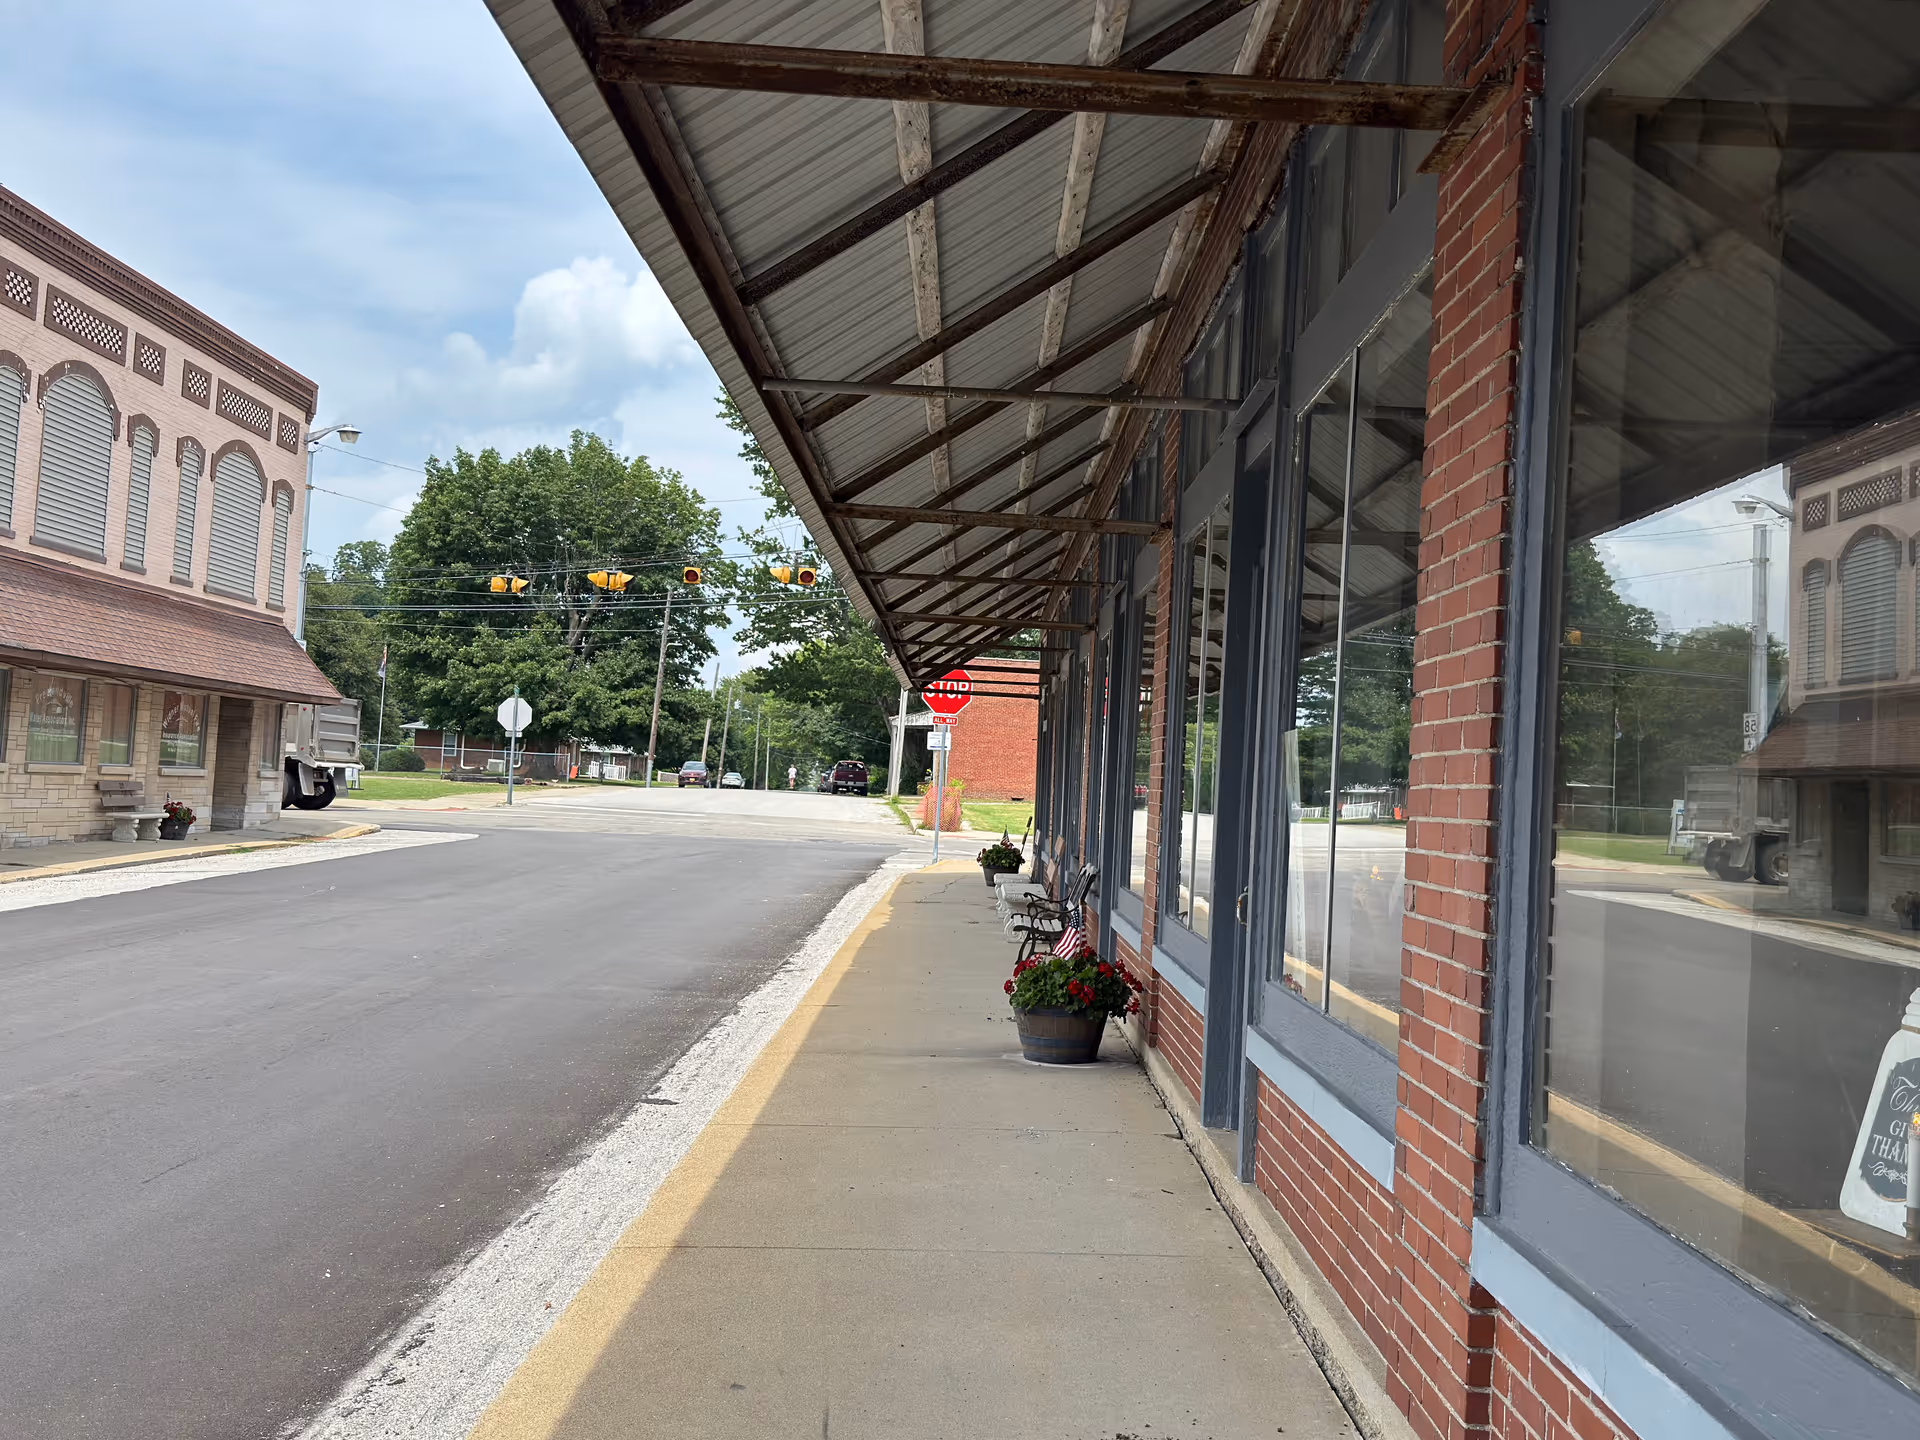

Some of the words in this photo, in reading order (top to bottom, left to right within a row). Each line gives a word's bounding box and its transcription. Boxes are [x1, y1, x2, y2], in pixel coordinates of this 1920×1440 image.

[925, 680, 969, 699] STOP
[1890, 1120, 1908, 1138] GI
[1871, 1134, 1908, 1165] THAN
